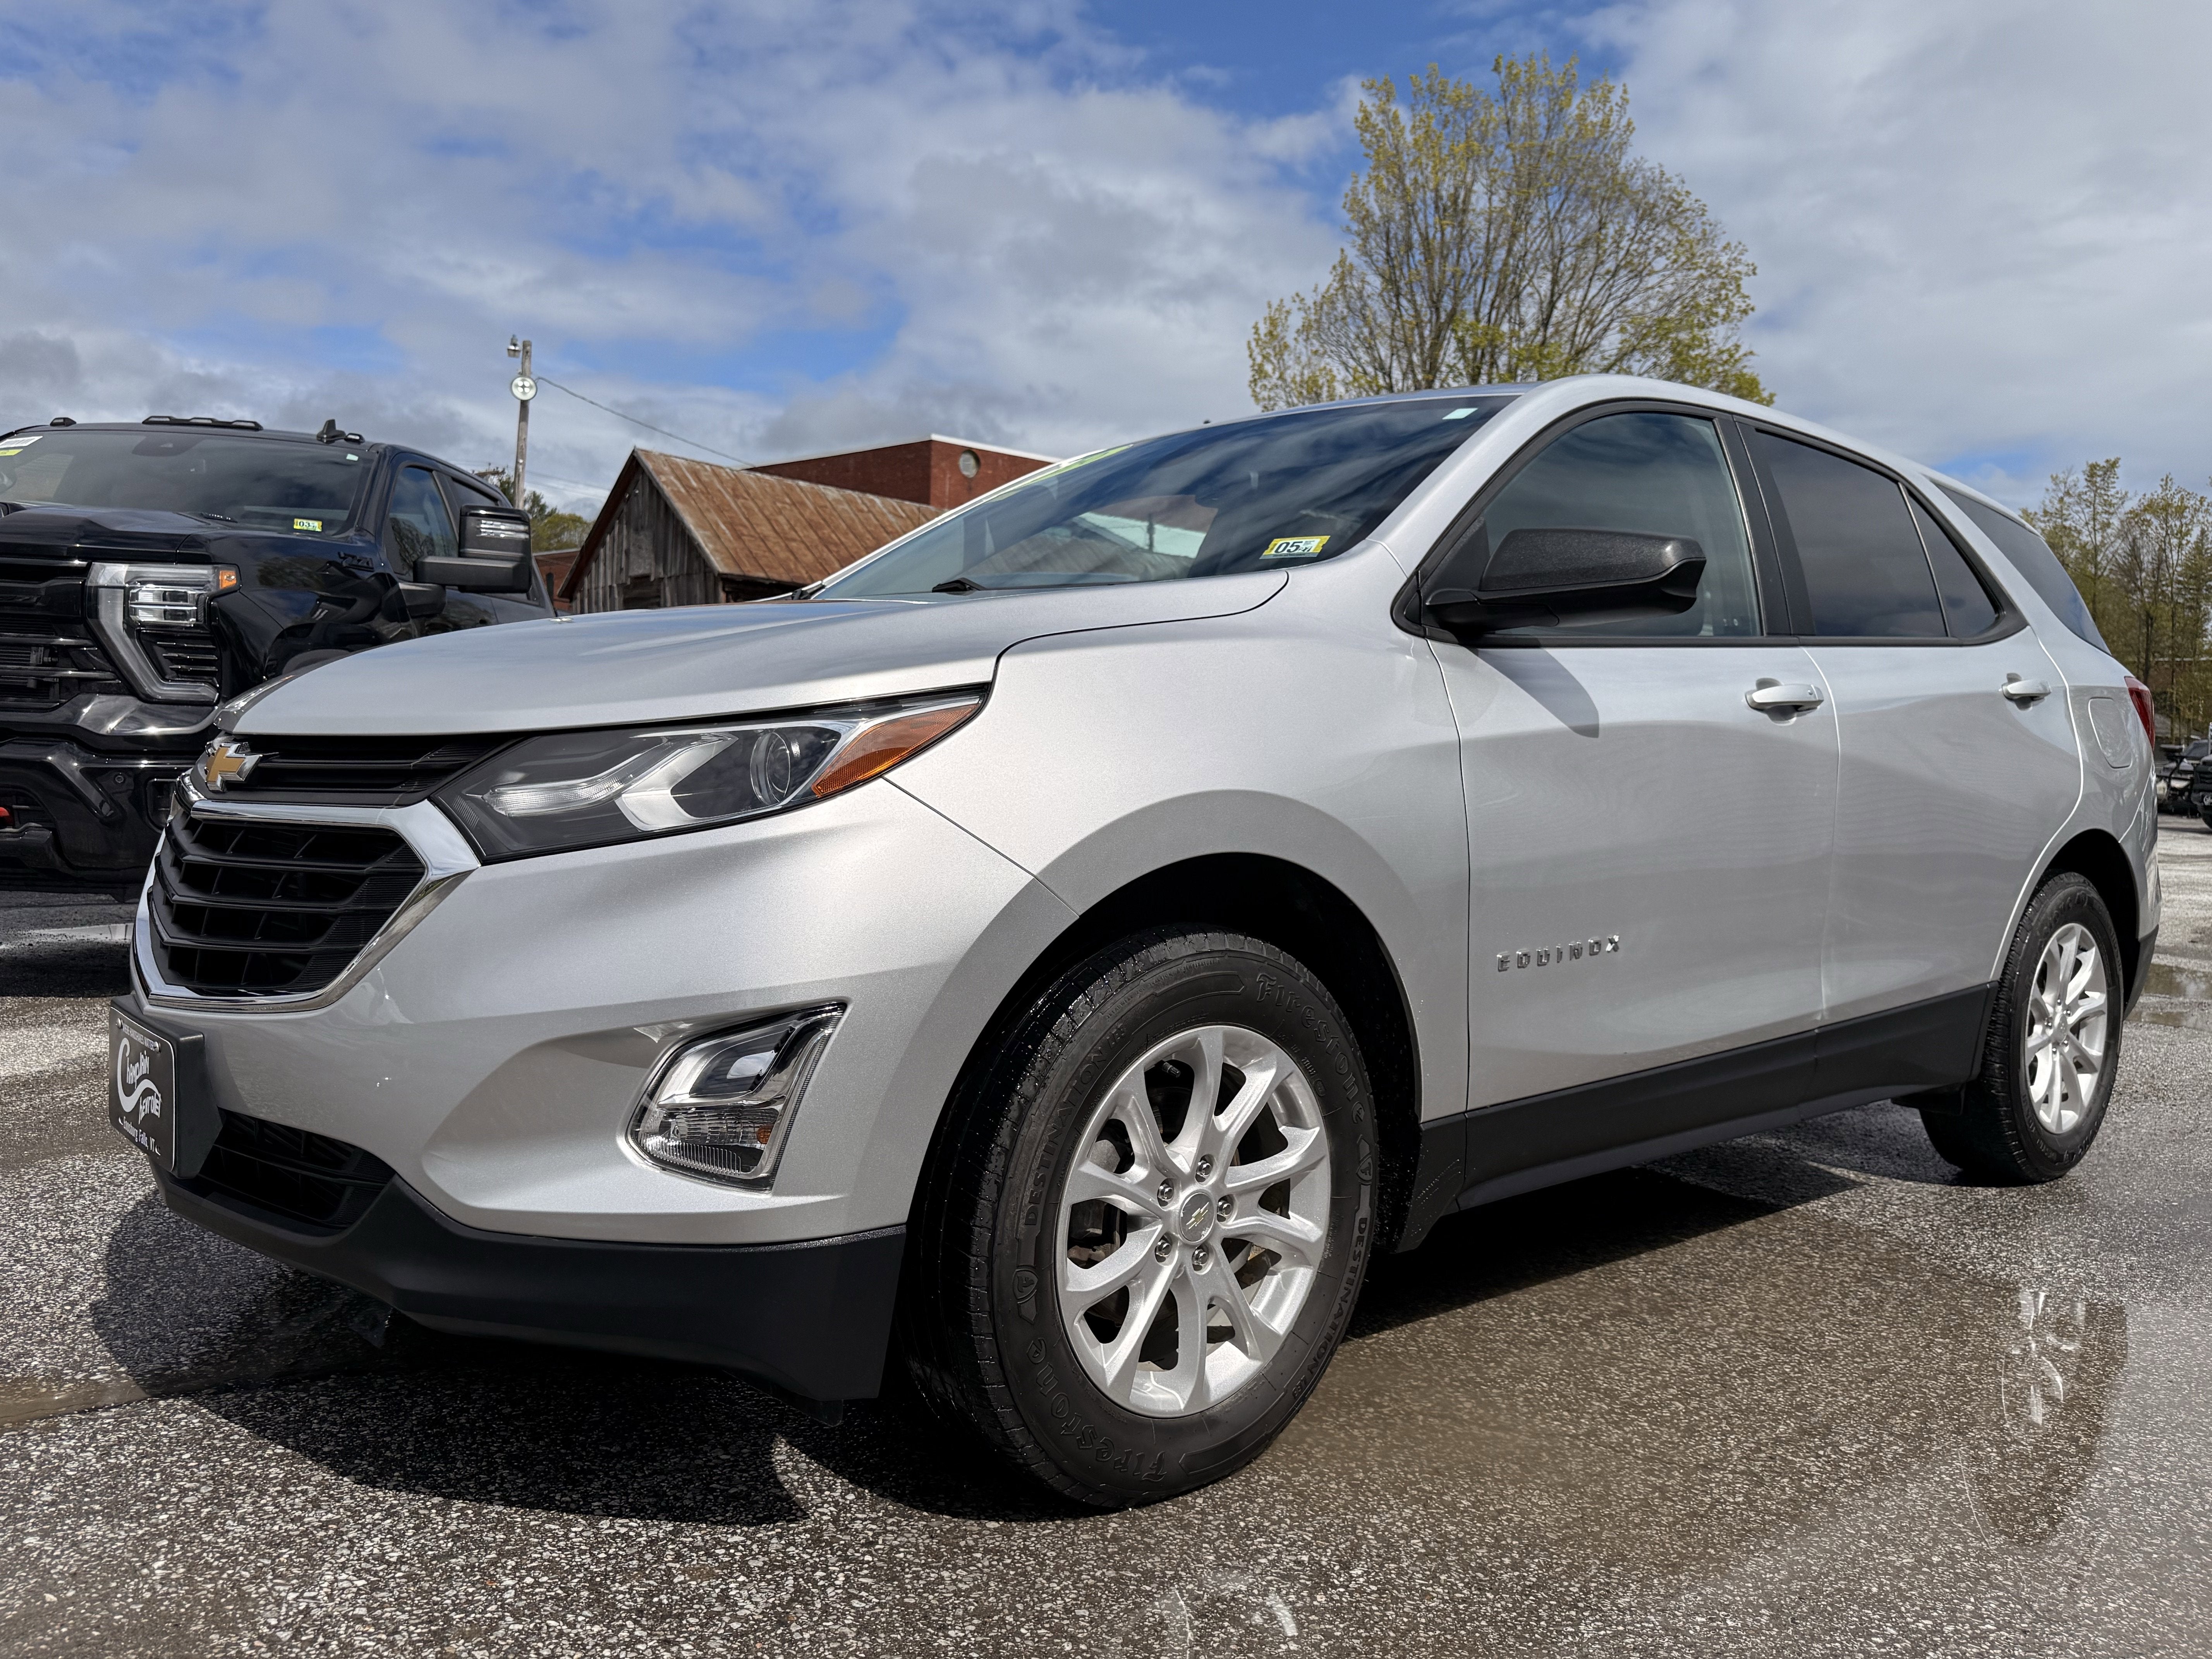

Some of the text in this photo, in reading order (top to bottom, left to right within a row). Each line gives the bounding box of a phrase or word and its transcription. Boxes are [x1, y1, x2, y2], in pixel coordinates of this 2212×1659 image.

[1274, 541, 1303, 553] 05
[1496, 934, 1620, 972] EQUINOX
[1256, 972, 1365, 1124] Firestone
[149, 1137, 155, 1152] VT
[1024, 1047, 1106, 1226] DESTINATION
[1307, 1217, 1367, 1375] DESTINATION
[1026, 1337, 1168, 1482] Firestone
